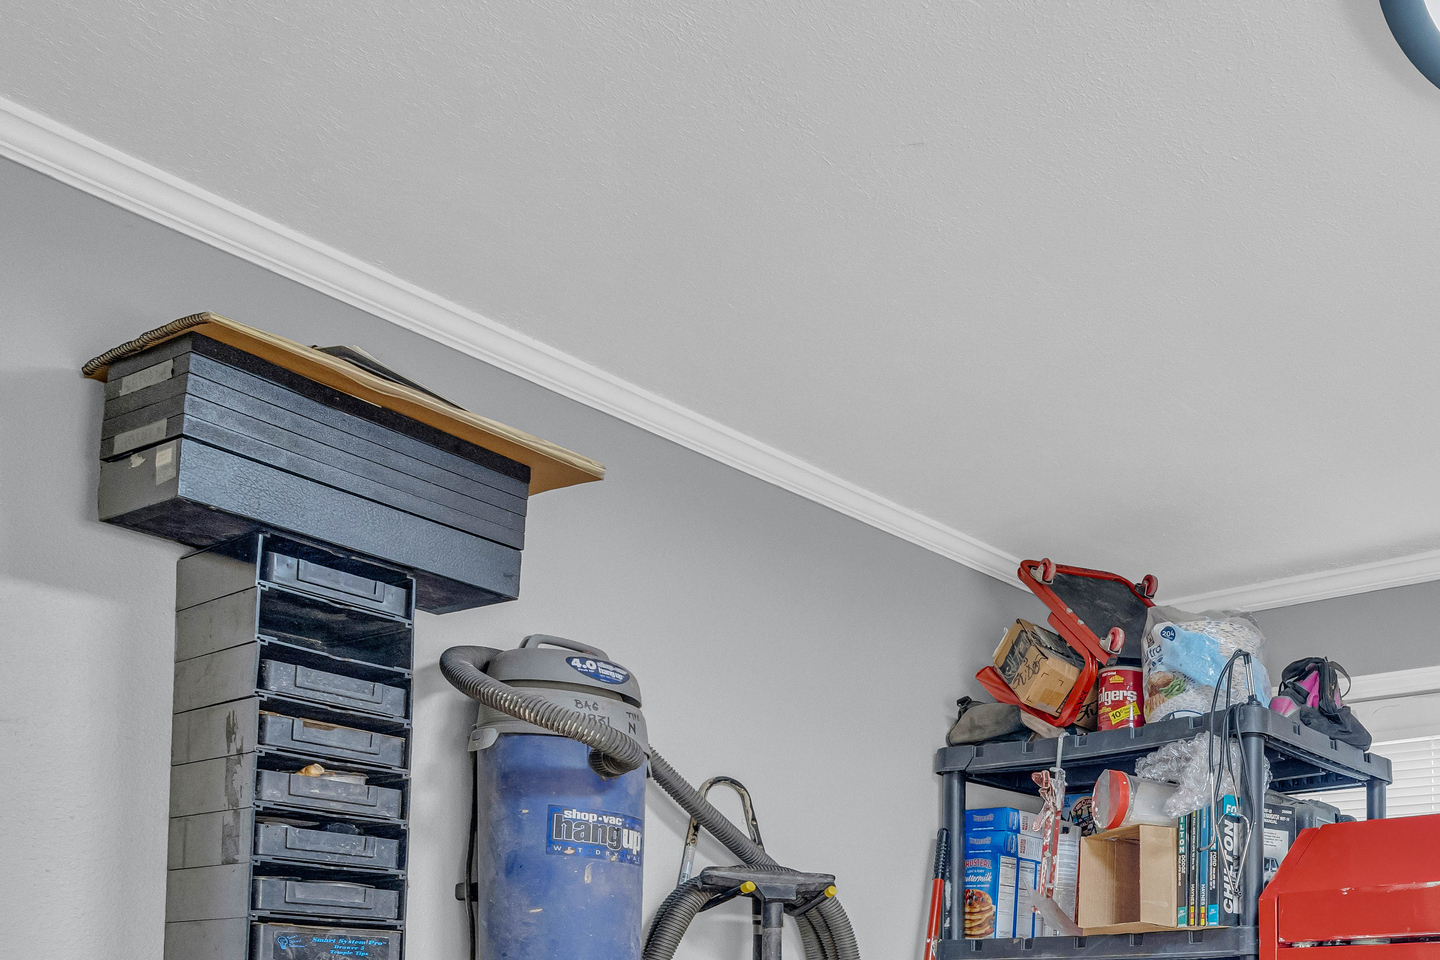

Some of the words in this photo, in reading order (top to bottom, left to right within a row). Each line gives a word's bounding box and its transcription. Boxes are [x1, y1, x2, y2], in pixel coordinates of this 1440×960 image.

[1161, 630, 1174, 638] 204
[571, 658, 598, 670] 4.0
[574, 699, 599, 712] BAG
[626, 712, 640, 722] TYPE
[628, 722, 637, 735] N
[312, 936, 336, 944] Smart
